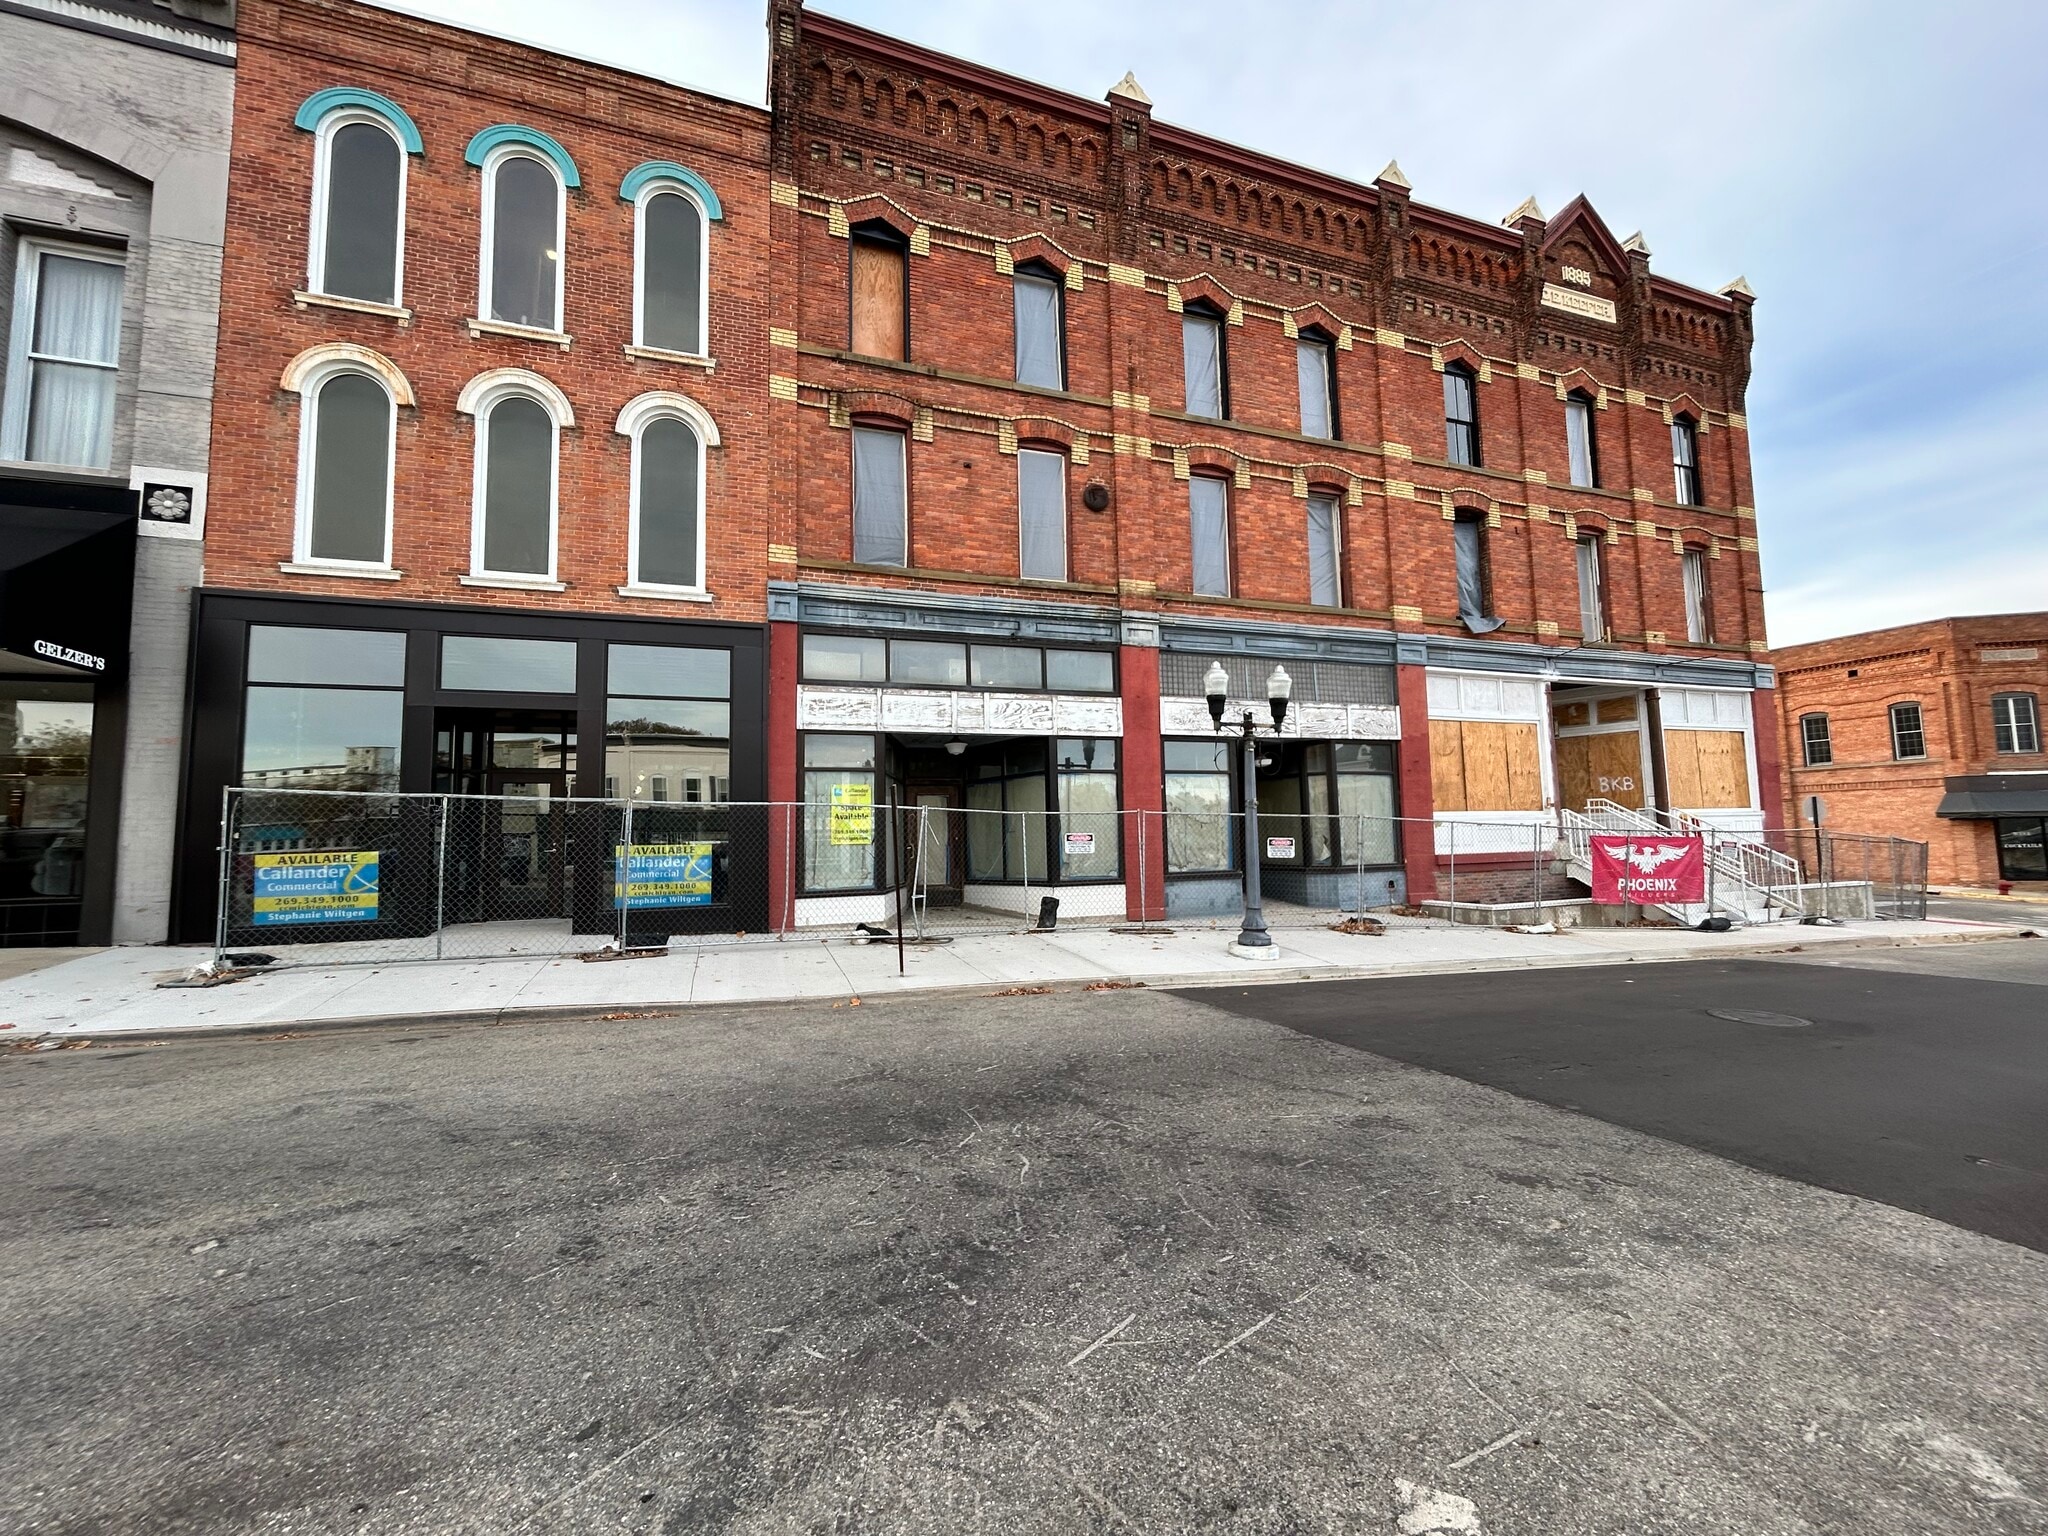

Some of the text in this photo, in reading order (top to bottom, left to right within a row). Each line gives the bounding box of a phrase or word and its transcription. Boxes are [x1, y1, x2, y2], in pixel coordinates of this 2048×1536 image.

[1561, 265, 1591, 287] 1885
[34, 640, 105, 670] GELZER'S
[1599, 776, 1634, 792] BKB
[633, 846, 696, 855] AVAILABLE
[278, 853, 358, 865] AVAILABLE
[258, 865, 347, 880] Callander
[267, 881, 337, 892] Commercial
[1618, 878, 1678, 891] PHOENIX
[275, 895, 359, 906] 269.349.1000
[626, 896, 701, 906] Stephanie Wiltgen
[268, 908, 365, 921] Stephanie Wiltgen
